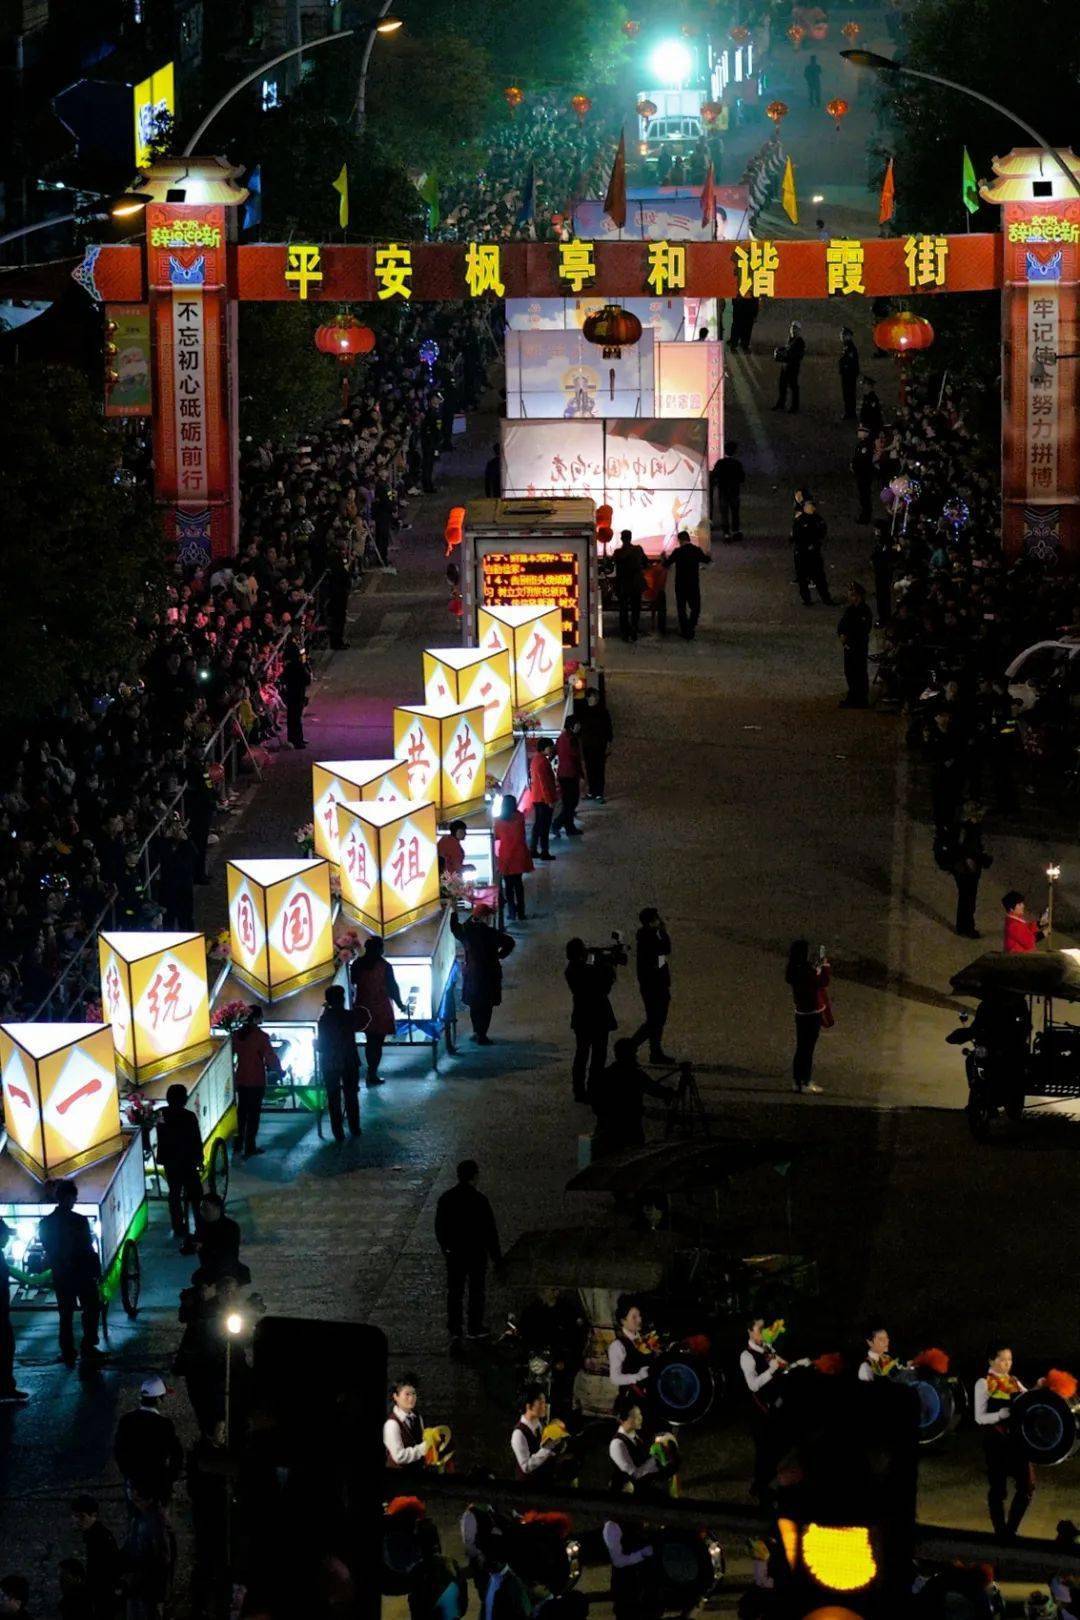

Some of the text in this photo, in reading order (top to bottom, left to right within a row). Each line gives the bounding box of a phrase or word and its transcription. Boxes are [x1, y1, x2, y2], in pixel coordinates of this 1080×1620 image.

[173, 220, 198, 230] 2018
[1032, 216, 1057, 226] 2018
[285, 235, 948, 300] 平安枫亭和谐霞街
[177, 302, 203, 490] 不忘初心砥砺前行
[392, 836, 426, 890] 祖
[56, 1079, 102, 1115] 一
